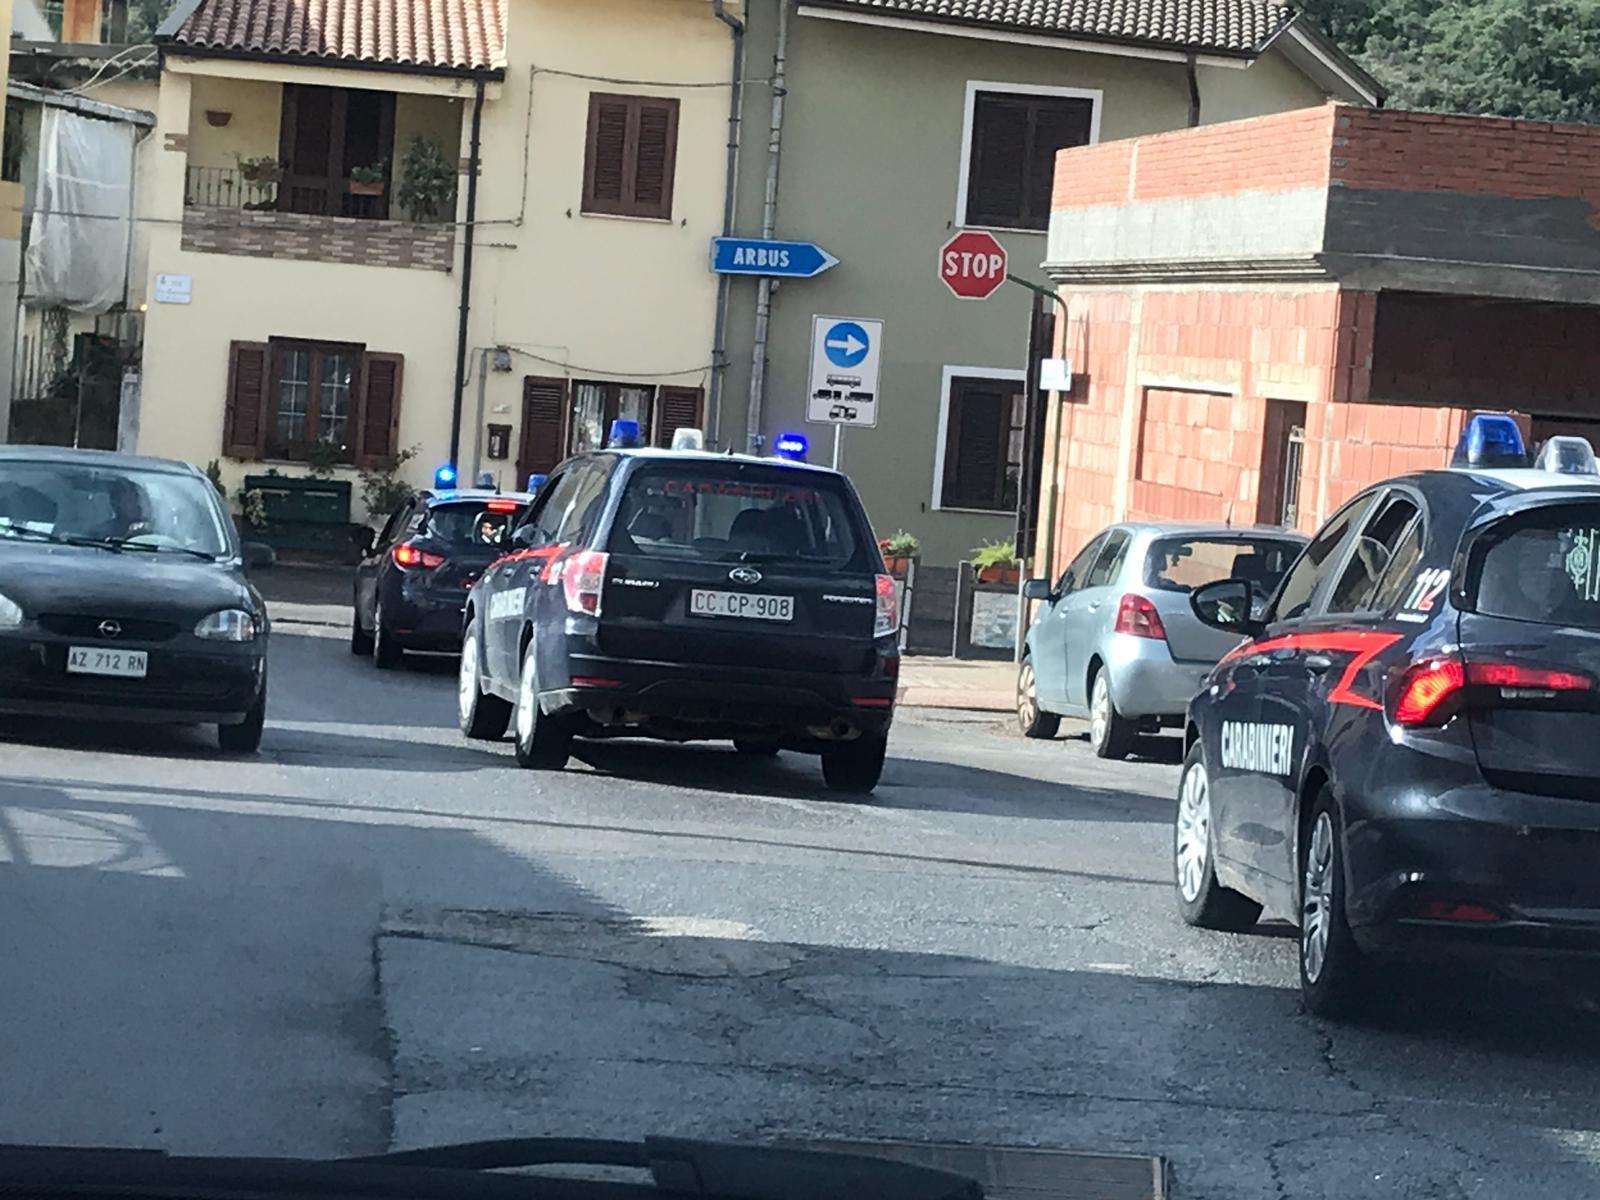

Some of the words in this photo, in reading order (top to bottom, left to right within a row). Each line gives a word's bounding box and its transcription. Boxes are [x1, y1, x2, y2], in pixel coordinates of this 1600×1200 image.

[733, 247, 790, 268] ARBUS
[945, 251, 1003, 279] STOP
[1403, 567, 1451, 611] 112
[70, 652, 88, 667] AZ
[95, 653, 121, 670] 712
[128, 655, 145, 671] RN
[1221, 720, 1294, 776] CARABINIERI
